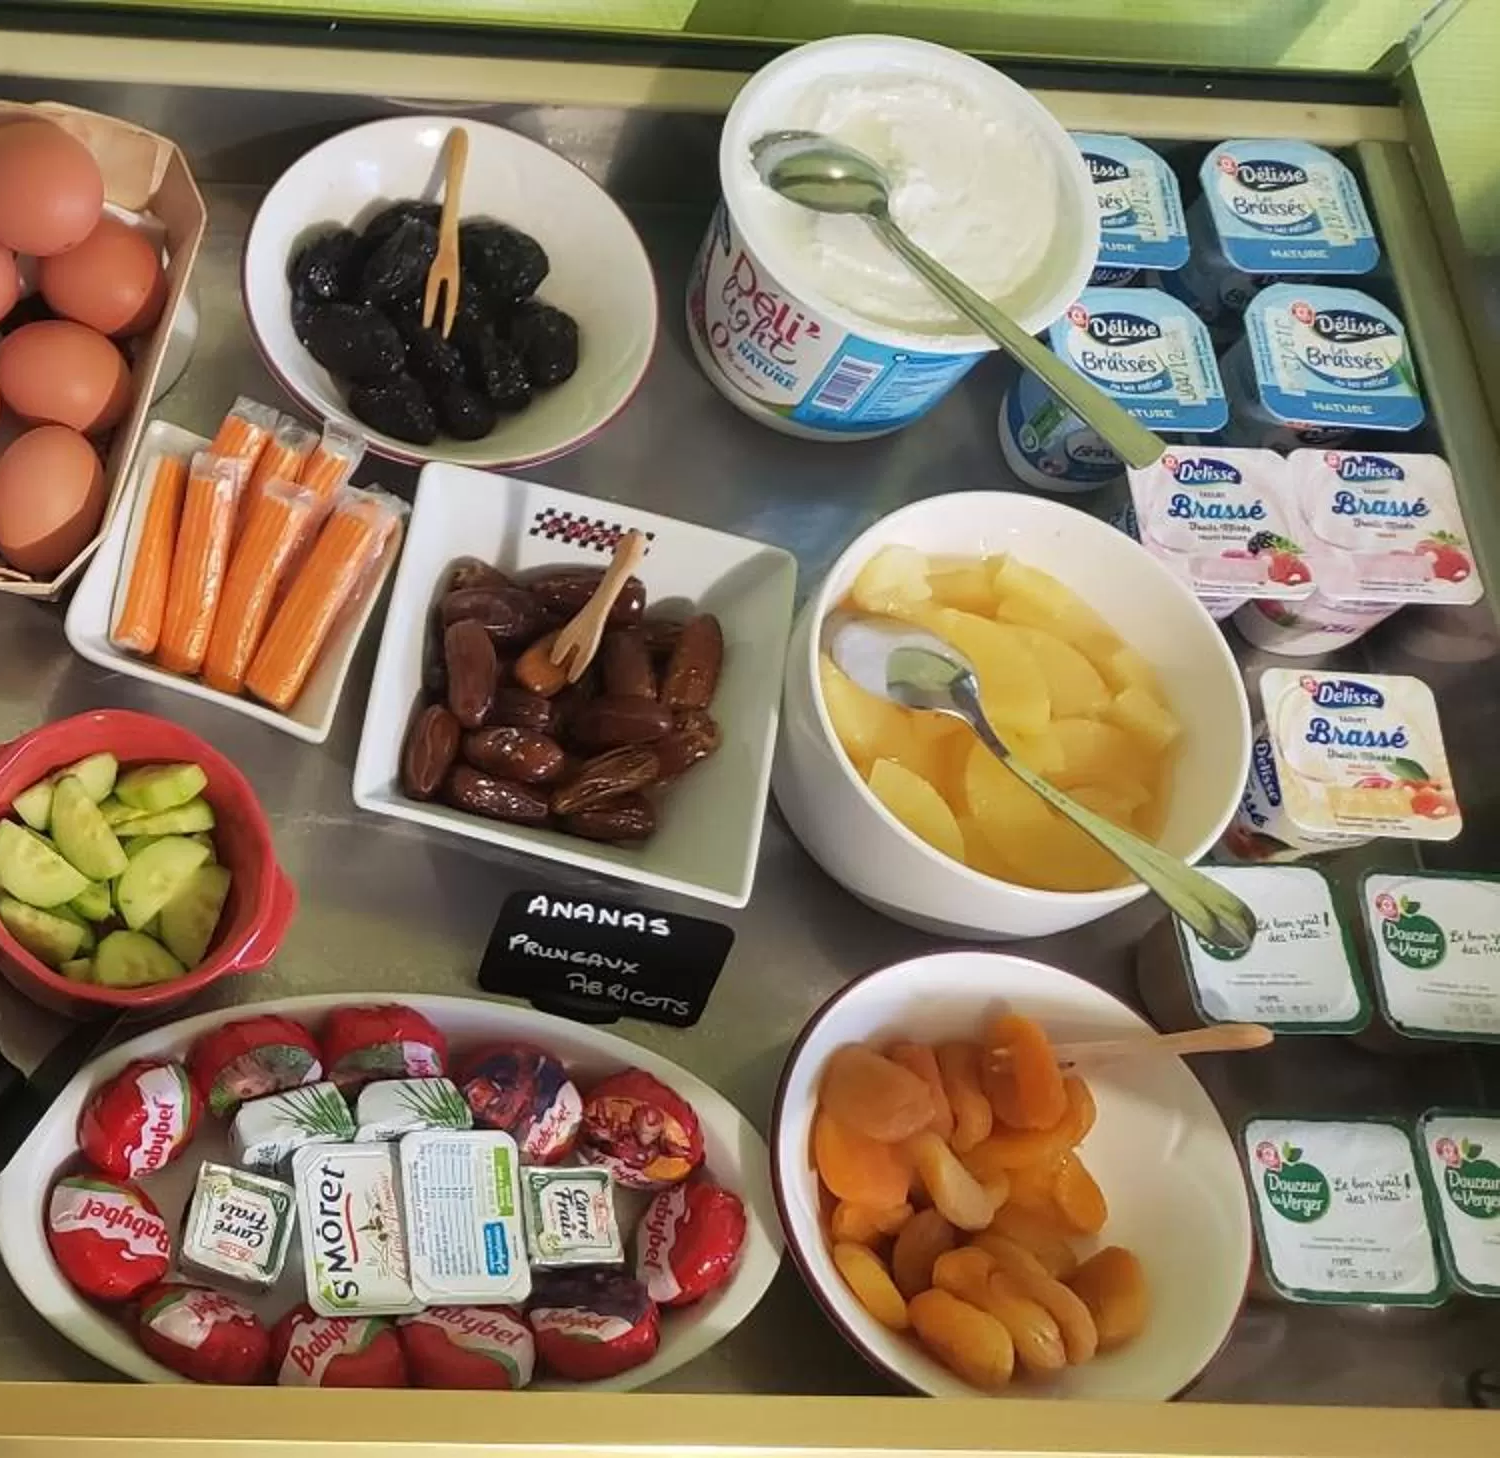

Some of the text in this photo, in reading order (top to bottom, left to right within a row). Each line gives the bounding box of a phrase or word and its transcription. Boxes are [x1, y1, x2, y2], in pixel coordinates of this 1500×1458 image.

[1240, 164, 1305, 184] Délisse
[1233, 194, 1308, 217] Brassés
[1269, 248, 1329, 259] NATURE
[1091, 316, 1159, 337] Délisse
[1317, 314, 1388, 335] Délisse
[1081, 351, 1158, 373] Brassés
[1305, 345, 1384, 371] Brassés
[1127, 408, 1177, 419] ATURE
[1311, 400, 1374, 415] NATURE
[1179, 460, 1238, 482] Délisse
[1341, 456, 1400, 479] Délisse
[1167, 493, 1269, 520] Brassé
[1331, 490, 1431, 518] Brassé
[1319, 681, 1380, 706] Délisse
[1305, 717, 1409, 749] Brassé
[527, 894, 672, 937] ANANAS
[1384, 921, 1438, 945] Douceur
[1398, 942, 1438, 964] Verger
[566, 973, 690, 1017] ABRICOTS
[1267, 1172, 1322, 1193] Douceur
[553, 1186, 574, 1240] Frais
[1283, 1192, 1324, 1217] Verger
[1462, 1190, 1500, 1213] Verge
[81, 1198, 172, 1252] Babybel
[216, 1202, 270, 1233] Frais
[316, 1160, 353, 1274] Môret
[573, 1188, 595, 1241] Carré
[211, 1219, 266, 1249] Carré
[430, 1306, 524, 1346] abybel
[291, 1317, 358, 1378] Babyb
